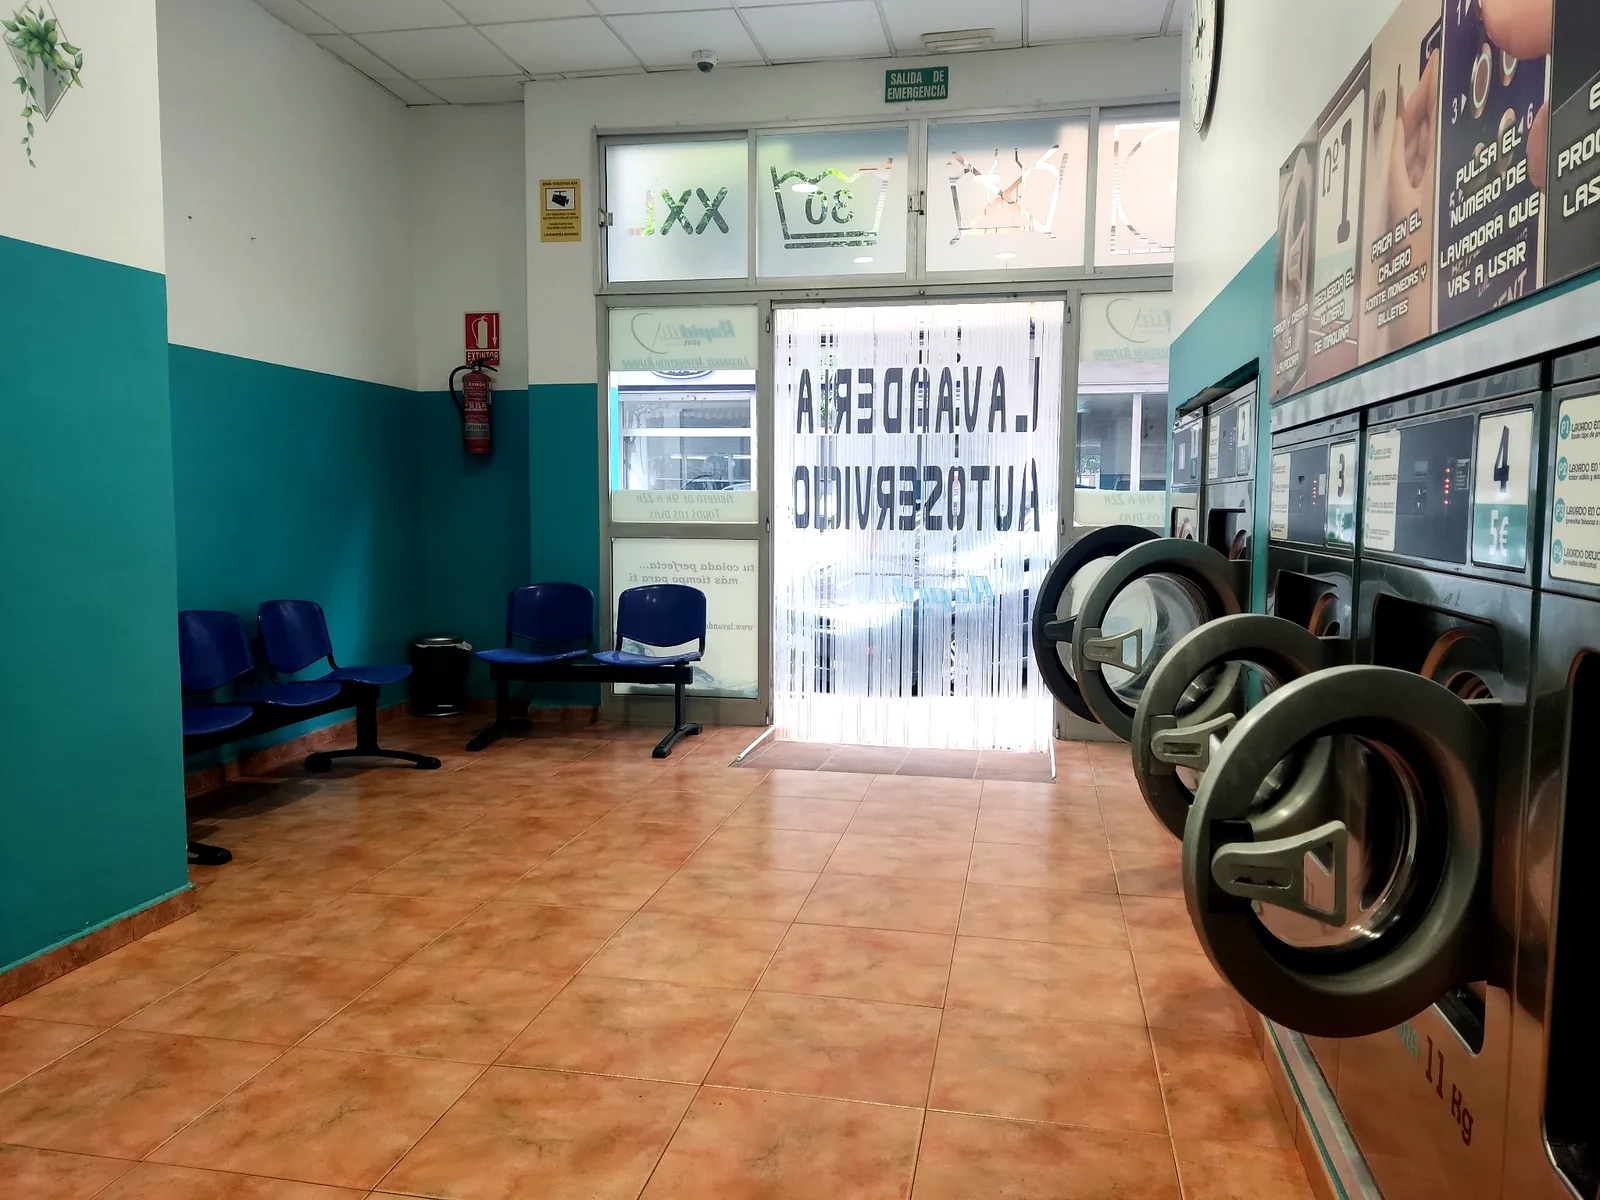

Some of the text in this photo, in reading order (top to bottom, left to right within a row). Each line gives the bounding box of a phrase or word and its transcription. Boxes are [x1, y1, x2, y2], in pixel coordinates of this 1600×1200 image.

[887, 84, 946, 100] EMERGENCIA
[890, 70, 945, 85] SALIDA DE
[1451, 97, 1458, 125] 3
[1526, 102, 1534, 130] 6
[1456, 126, 1522, 190] PULSA EL
[1336, 118, 1352, 244] 1
[1505, 158, 1527, 192] DE
[1371, 211, 1422, 260] PAGA EN EL
[1440, 214, 1503, 269] LAVADORA
[1508, 191, 1540, 229] QUE
[1345, 270, 1355, 288] EL
[1378, 247, 1411, 283] CAJERO
[1447, 269, 1471, 299] VAS
[1474, 263, 1484, 286] A
[1488, 240, 1526, 280] USAR
[1365, 264, 1427, 312] ADMITE MONEDAS Y
[1377, 299, 1409, 327] BILLETES
[467, 351, 499, 361] EXTINTOR
[1313, 339, 1322, 355] DE
[1571, 421, 1593, 433] LAVADO
[1493, 425, 1510, 493] 4
[1568, 462, 1590, 473] LAVADO
[1337, 453, 1346, 498] 3
[1566, 506, 1587, 516] LAVADO
[1487, 508, 1510, 558] 5€
[1563, 548, 1584, 559] LAVADO
[1425, 1035, 1444, 1101] 11
